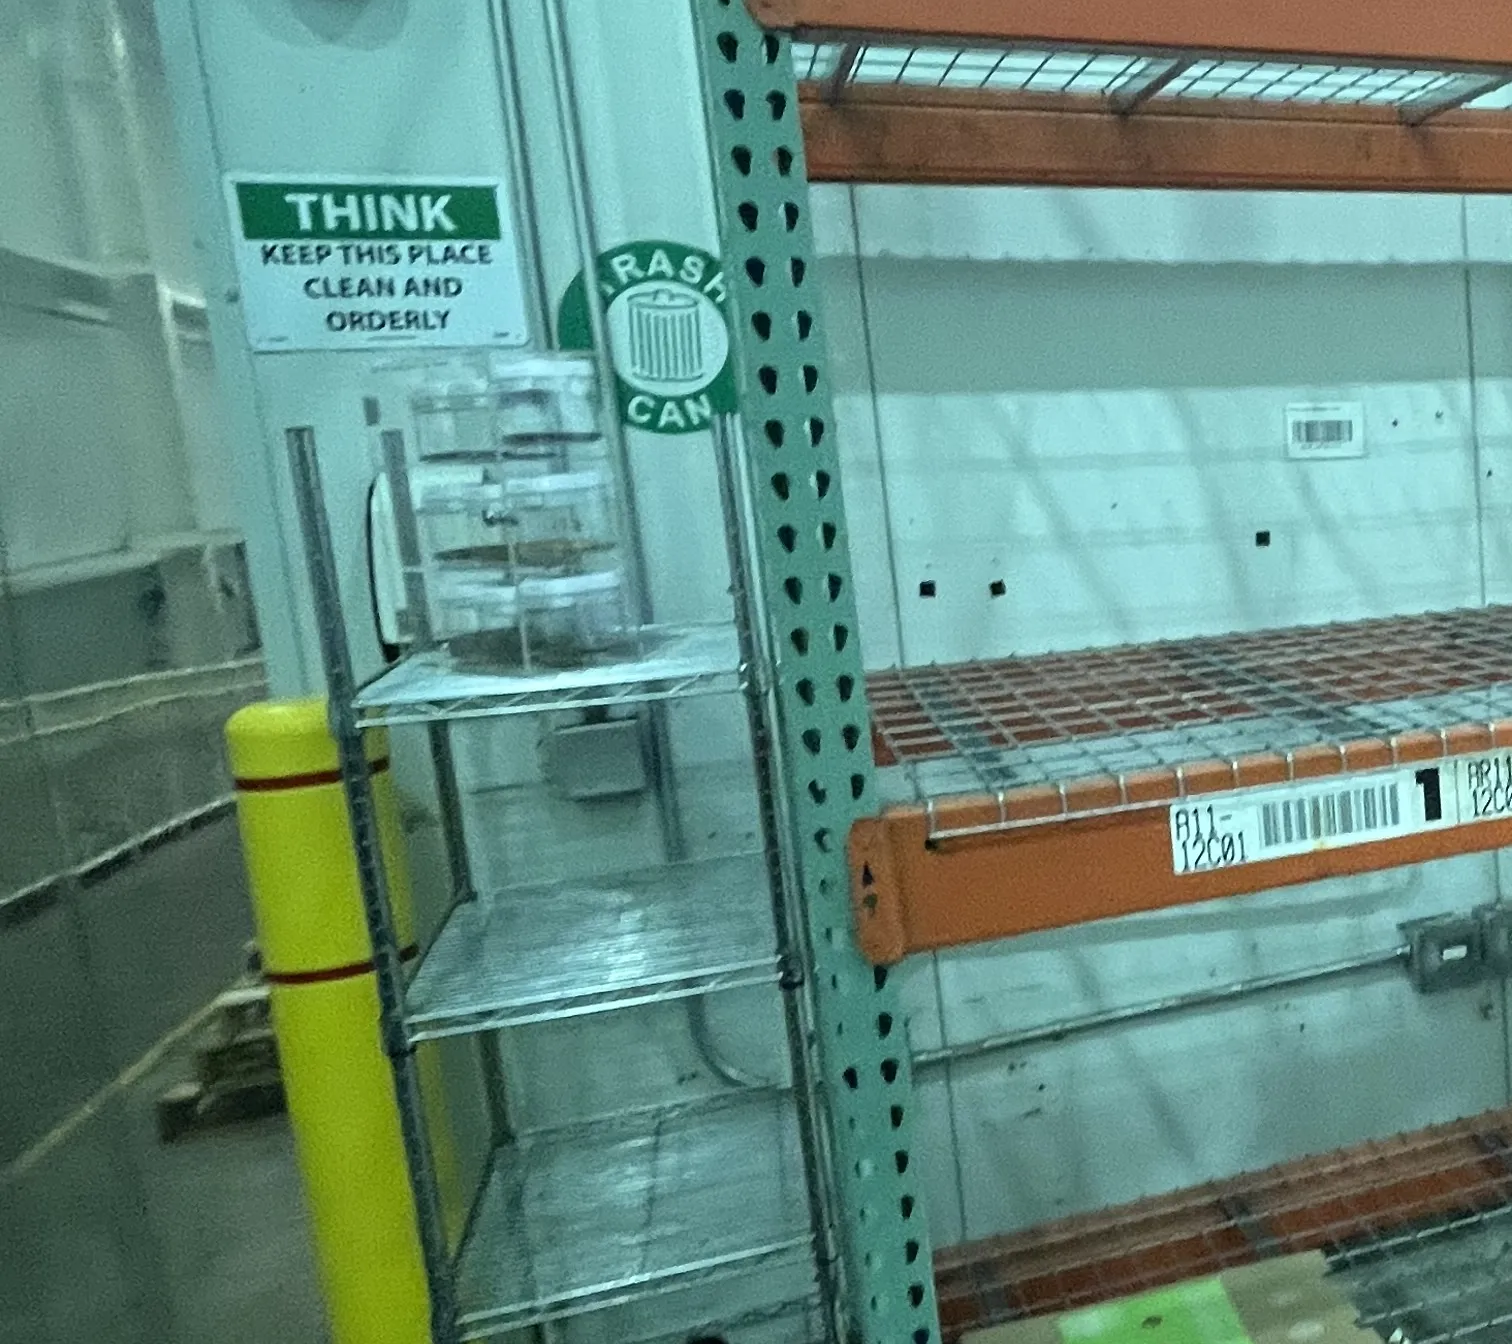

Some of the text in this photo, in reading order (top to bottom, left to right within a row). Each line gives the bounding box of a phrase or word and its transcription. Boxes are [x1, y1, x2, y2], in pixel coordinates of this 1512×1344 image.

[284, 193, 457, 232] THINK
[261, 244, 493, 266] KEEP THIS PLACE
[303, 276, 463, 299] CLEAN AND
[602, 248, 727, 303] RASH
[326, 310, 450, 332] ORDERLY
[628, 394, 712, 428] CAN
[1415, 768, 1442, 821] 1
[1175, 804, 1232, 841] A11-
[1182, 831, 1246, 872] 12C01
